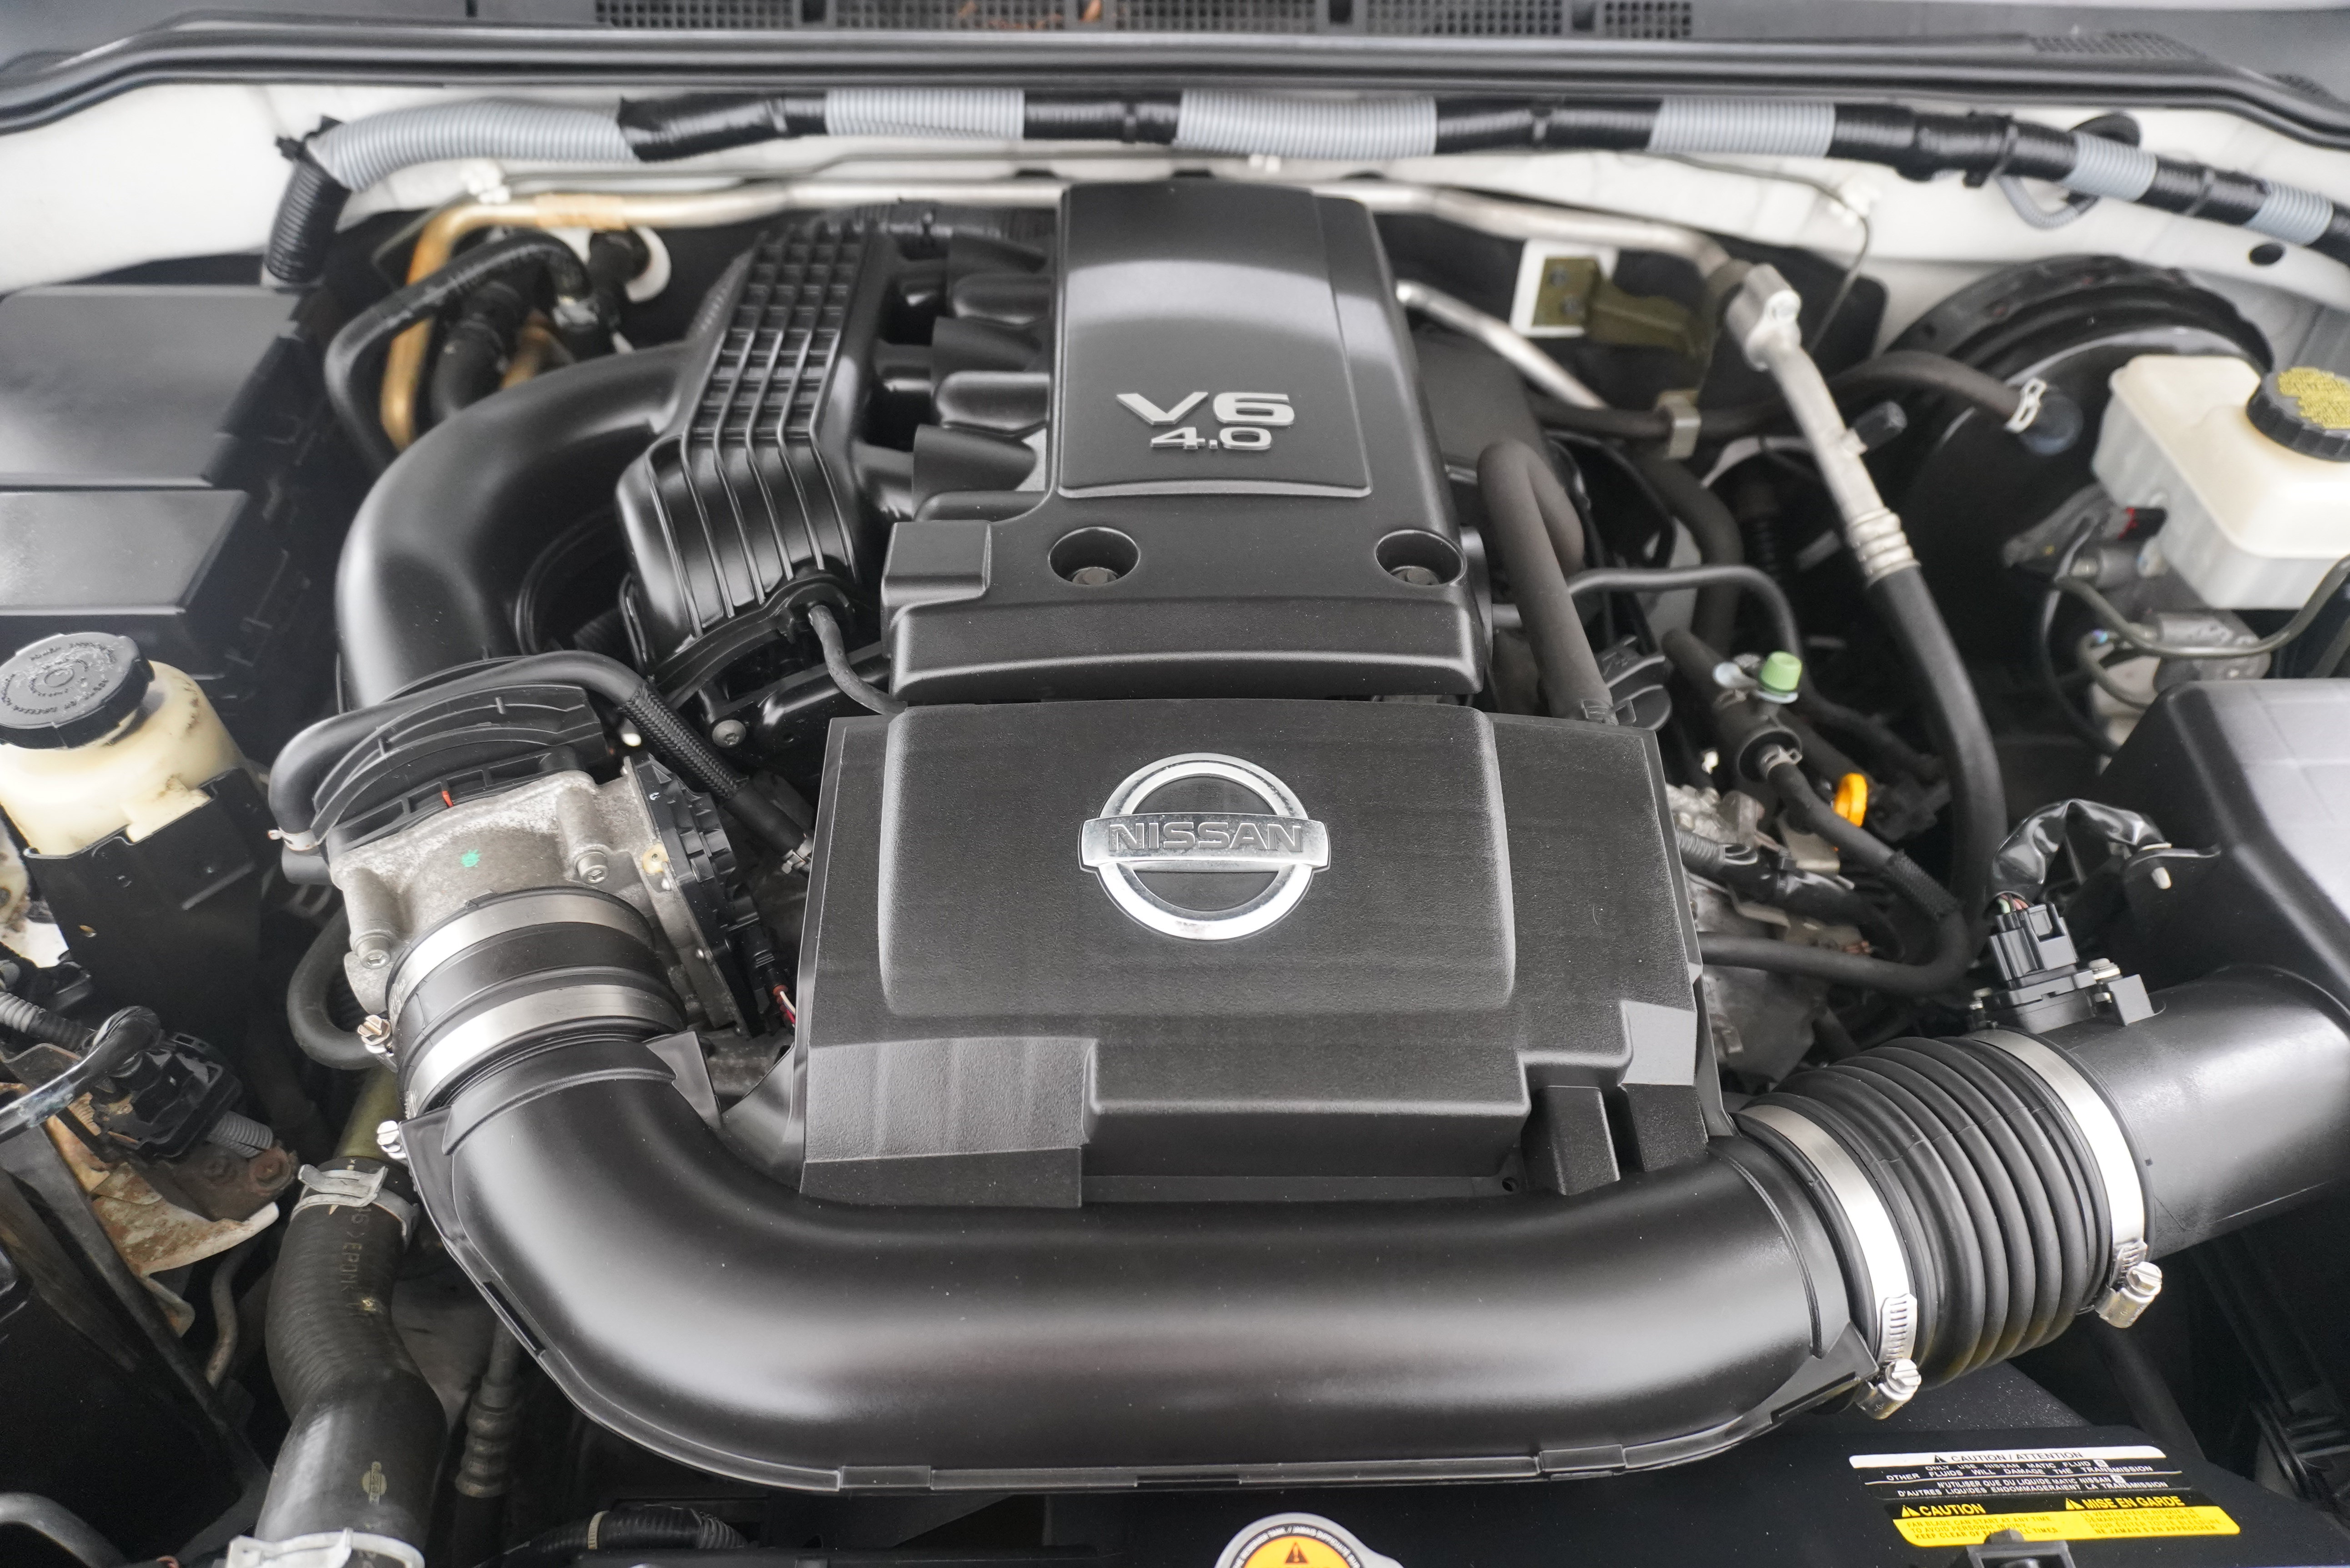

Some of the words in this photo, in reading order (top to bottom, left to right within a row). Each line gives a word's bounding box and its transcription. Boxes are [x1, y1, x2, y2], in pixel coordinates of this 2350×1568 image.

[1116, 392, 1295, 426] V6
[1150, 427, 1272, 451] 4.0
[1109, 821, 1303, 852] NISSAN
[1951, 1454, 2006, 1462] CAUTION
[2017, 1452, 2084, 1460] ATTENTION
[1886, 1473, 1921, 1481] OTHER
[2080, 1465, 2154, 1473] TRANSMISSION
[1897, 1488, 1943, 1497] D'AUTRES
[1990, 1484, 2081, 1493] ENDOMMAGERAIENT
[2100, 1481, 2169, 1489] TRANSMISSION
[1937, 1480, 1983, 1489] N'UTILISER
[1919, 1503, 1986, 1516] CAUTION
[2081, 1498, 2118, 1509] MISE
[2115, 1497, 2138, 1508] EN
[2136, 1495, 2185, 1507] GARDE
